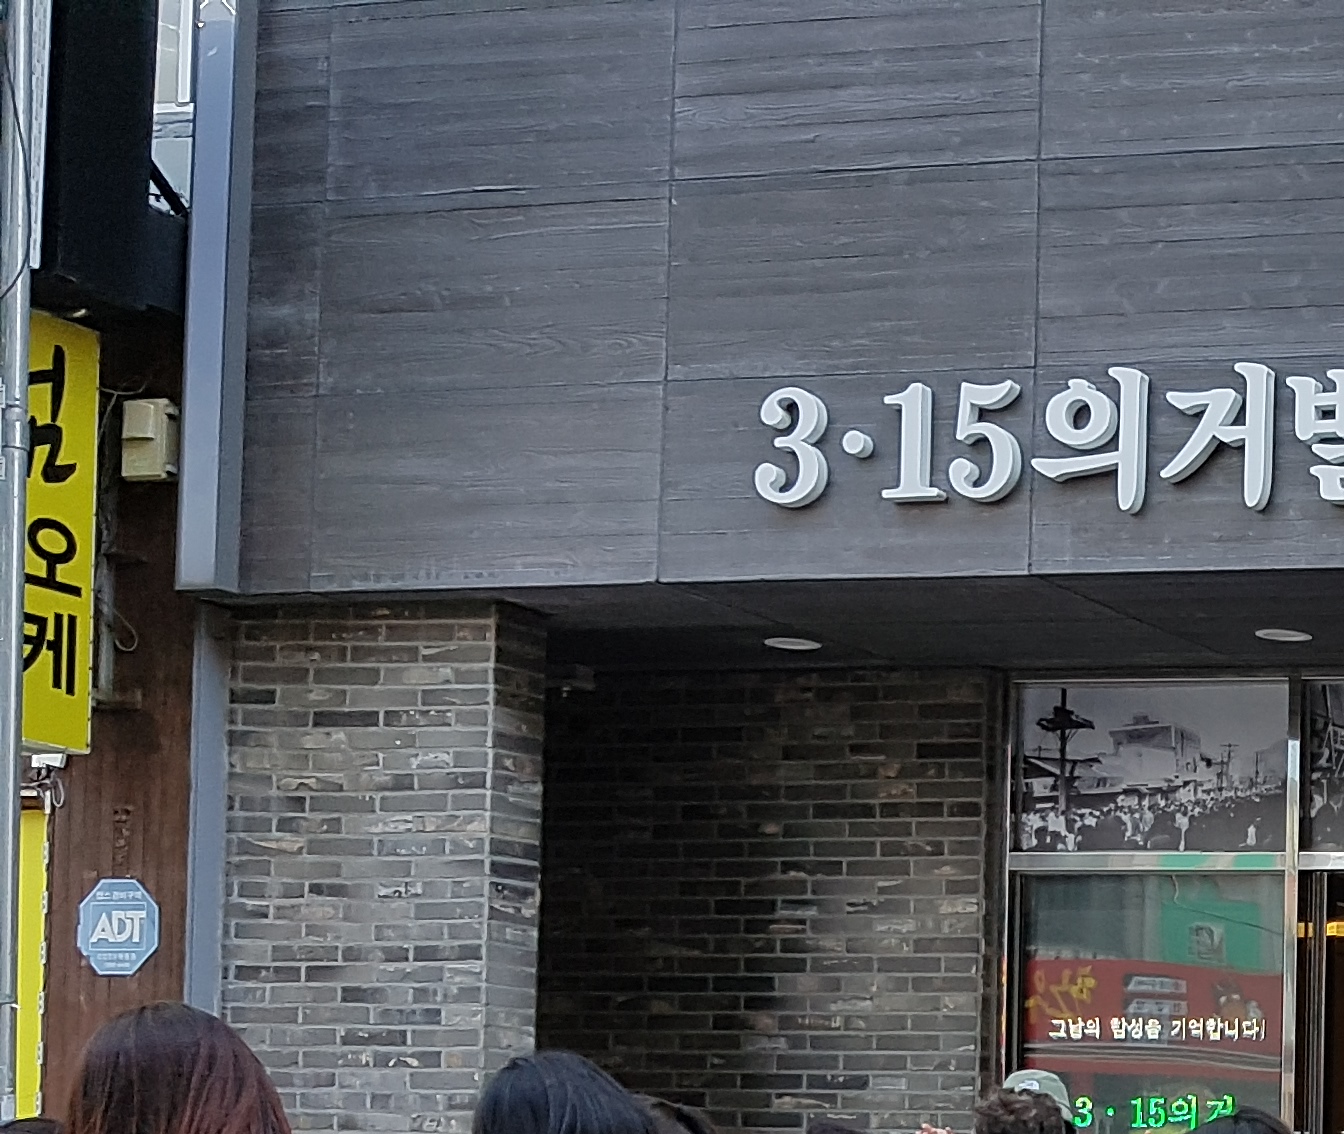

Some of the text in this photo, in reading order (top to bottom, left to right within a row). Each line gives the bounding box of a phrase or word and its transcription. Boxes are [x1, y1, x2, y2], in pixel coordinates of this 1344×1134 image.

[89, 910, 147, 943] ADT
[1048, 1016, 1101, 1040] 그날의
[1109, 1016, 1162, 1041] 함성을
